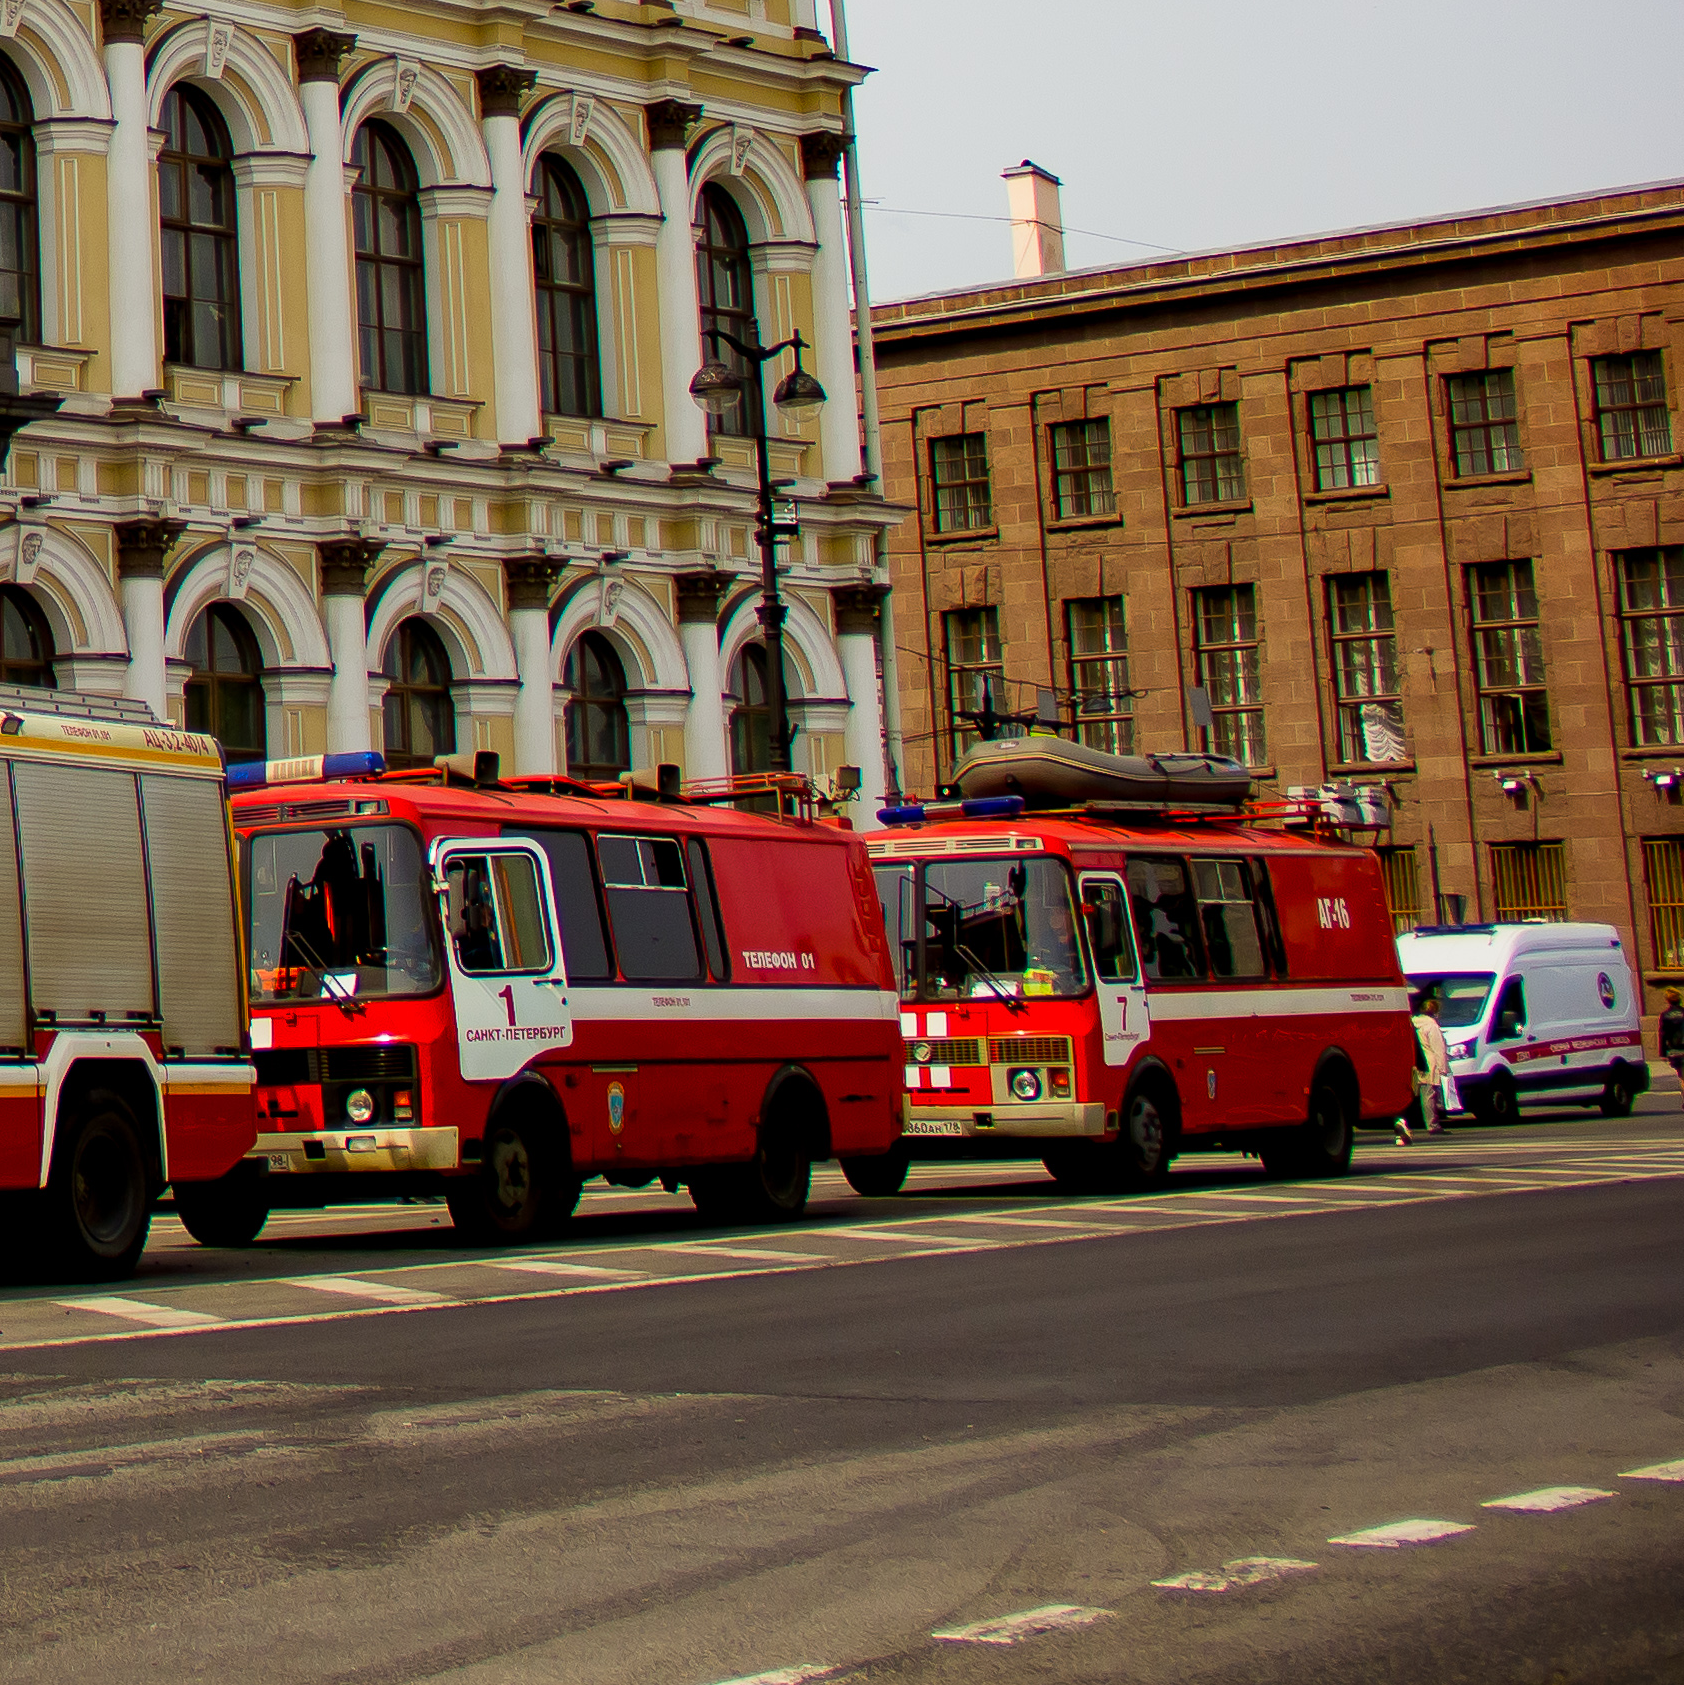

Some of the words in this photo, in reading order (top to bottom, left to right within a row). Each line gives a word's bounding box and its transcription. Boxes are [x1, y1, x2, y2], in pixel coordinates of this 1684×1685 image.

[1317, 897, 1350, 929] АГ-16
[742, 951, 797, 969] ТЕЛЕФОН
[801, 952, 815, 969] 01
[498, 985, 516, 1027] 1
[1117, 996, 1128, 1032] 7
[466, 1025, 566, 1042] САНКТ-ПЕТЕРБУРГ
